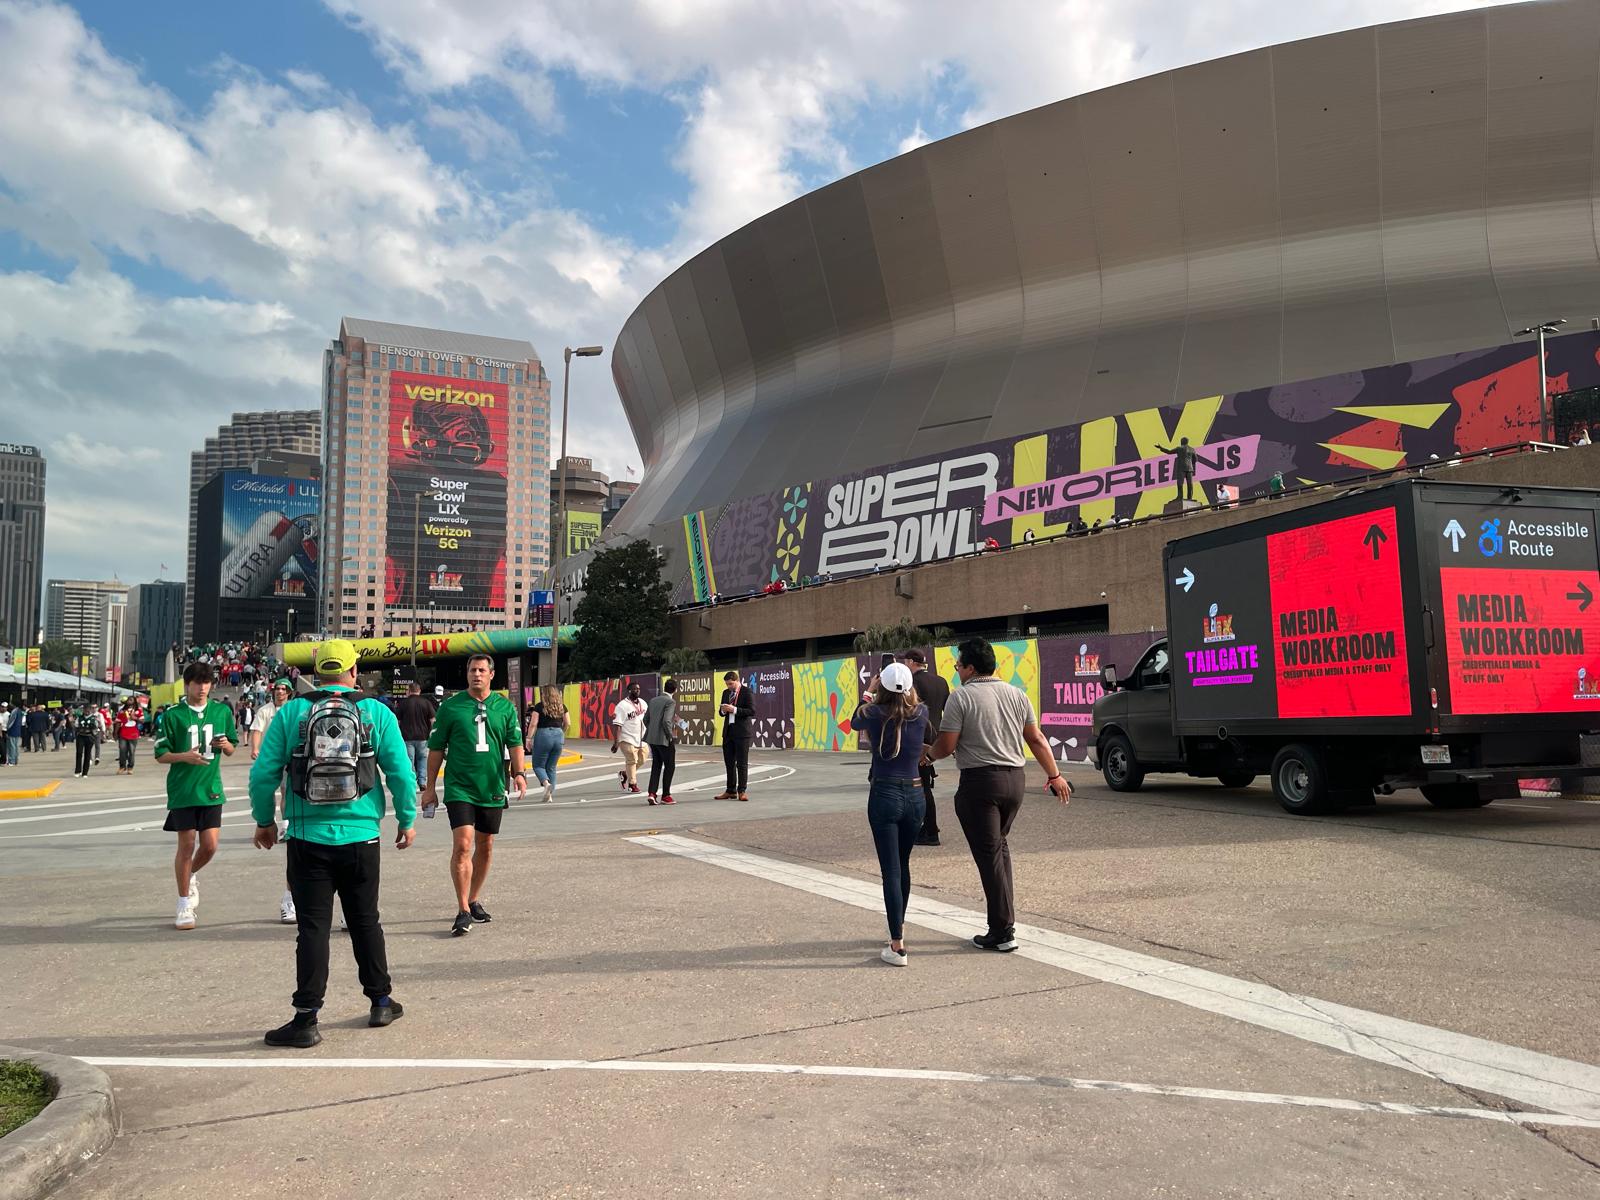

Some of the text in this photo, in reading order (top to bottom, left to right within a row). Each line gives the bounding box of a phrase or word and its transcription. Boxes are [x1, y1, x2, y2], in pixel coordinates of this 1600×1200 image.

[380, 345, 516, 369] BENSON TOWER Ochsner
[404, 384, 495, 408] verizon
[0, 445, 33, 455] nkPlus
[568, 457, 592, 466] HYATT
[231, 480, 285, 494] Michelob
[430, 477, 469, 491] Super
[824, 452, 1000, 529] SUPER
[433, 490, 466, 503] Bowl
[997, 484, 1055, 516] NEW
[438, 503, 460, 515] LIX
[460, 516, 469, 525] by
[424, 524, 472, 537] Verizon
[1507, 520, 1589, 538] Accessible
[438, 537, 459, 549] 5G
[818, 507, 987, 576] BOWL
[1509, 540, 1554, 556] Route
[225, 543, 275, 593] ULTRA
[546, 591, 554, 604] A
[1458, 594, 1527, 623] MEDIA
[1279, 606, 1338, 637] MEDIA
[422, 639, 450, 655] LIX
[532, 638, 550, 648] Clara
[1281, 631, 1394, 666] WORKROOM
[1460, 627, 1584, 655] WORKROOM
[1185, 645, 1258, 674] TAILGATE
[1463, 660, 1510, 670] CREDENTIALED
[1512, 661, 1533, 669] MEDIA
[760, 670, 790, 681] Accessible
[1352, 664, 1372, 674] STAFF
[680, 678, 710, 692] STADIUM
[1463, 674, 1505, 684] STAFF ONLY
[759, 685, 776, 694] Route
[1053, 683, 1108, 705] TAILGA
[475, 714, 490, 752] 1
[188, 724, 215, 759] 11
